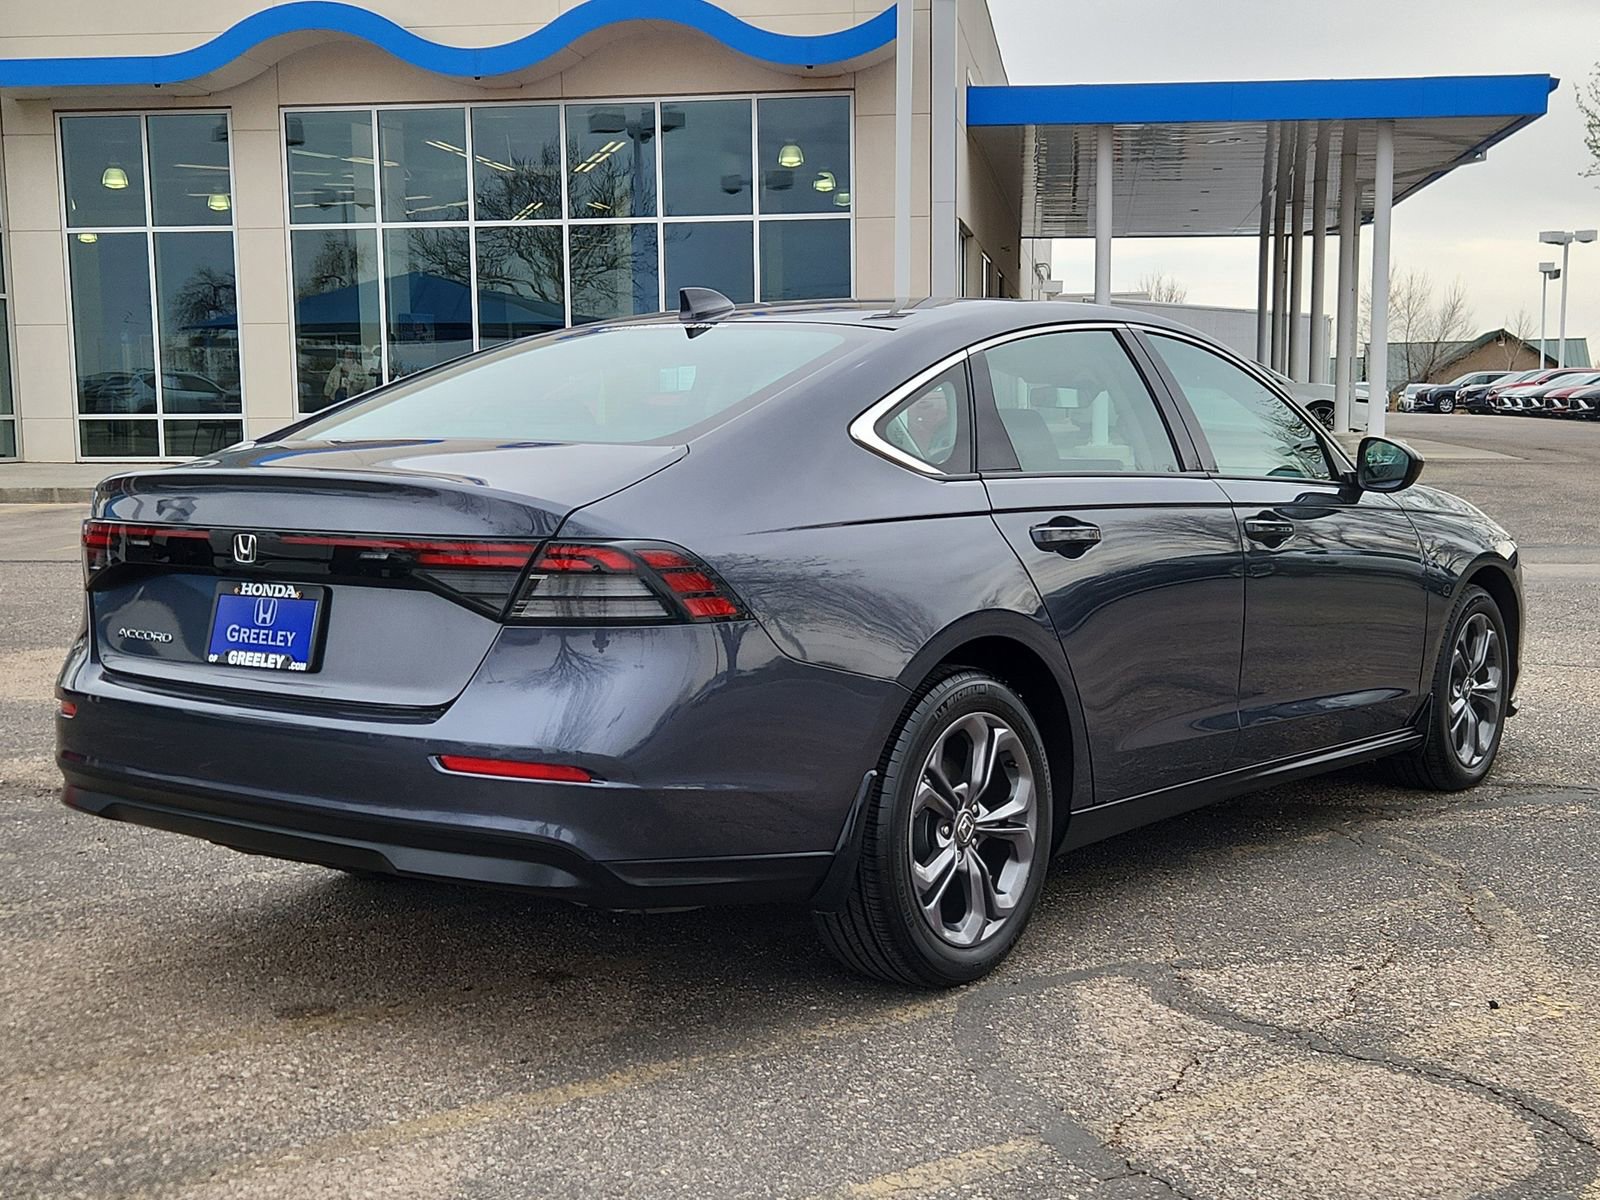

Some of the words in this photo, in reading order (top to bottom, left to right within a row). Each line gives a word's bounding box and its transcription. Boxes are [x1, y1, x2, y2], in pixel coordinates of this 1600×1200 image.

[240, 582, 298, 598] HONDA
[118, 627, 173, 643] ACCORD
[226, 624, 296, 647] GREELEY
[227, 650, 286, 669] GREELEY
